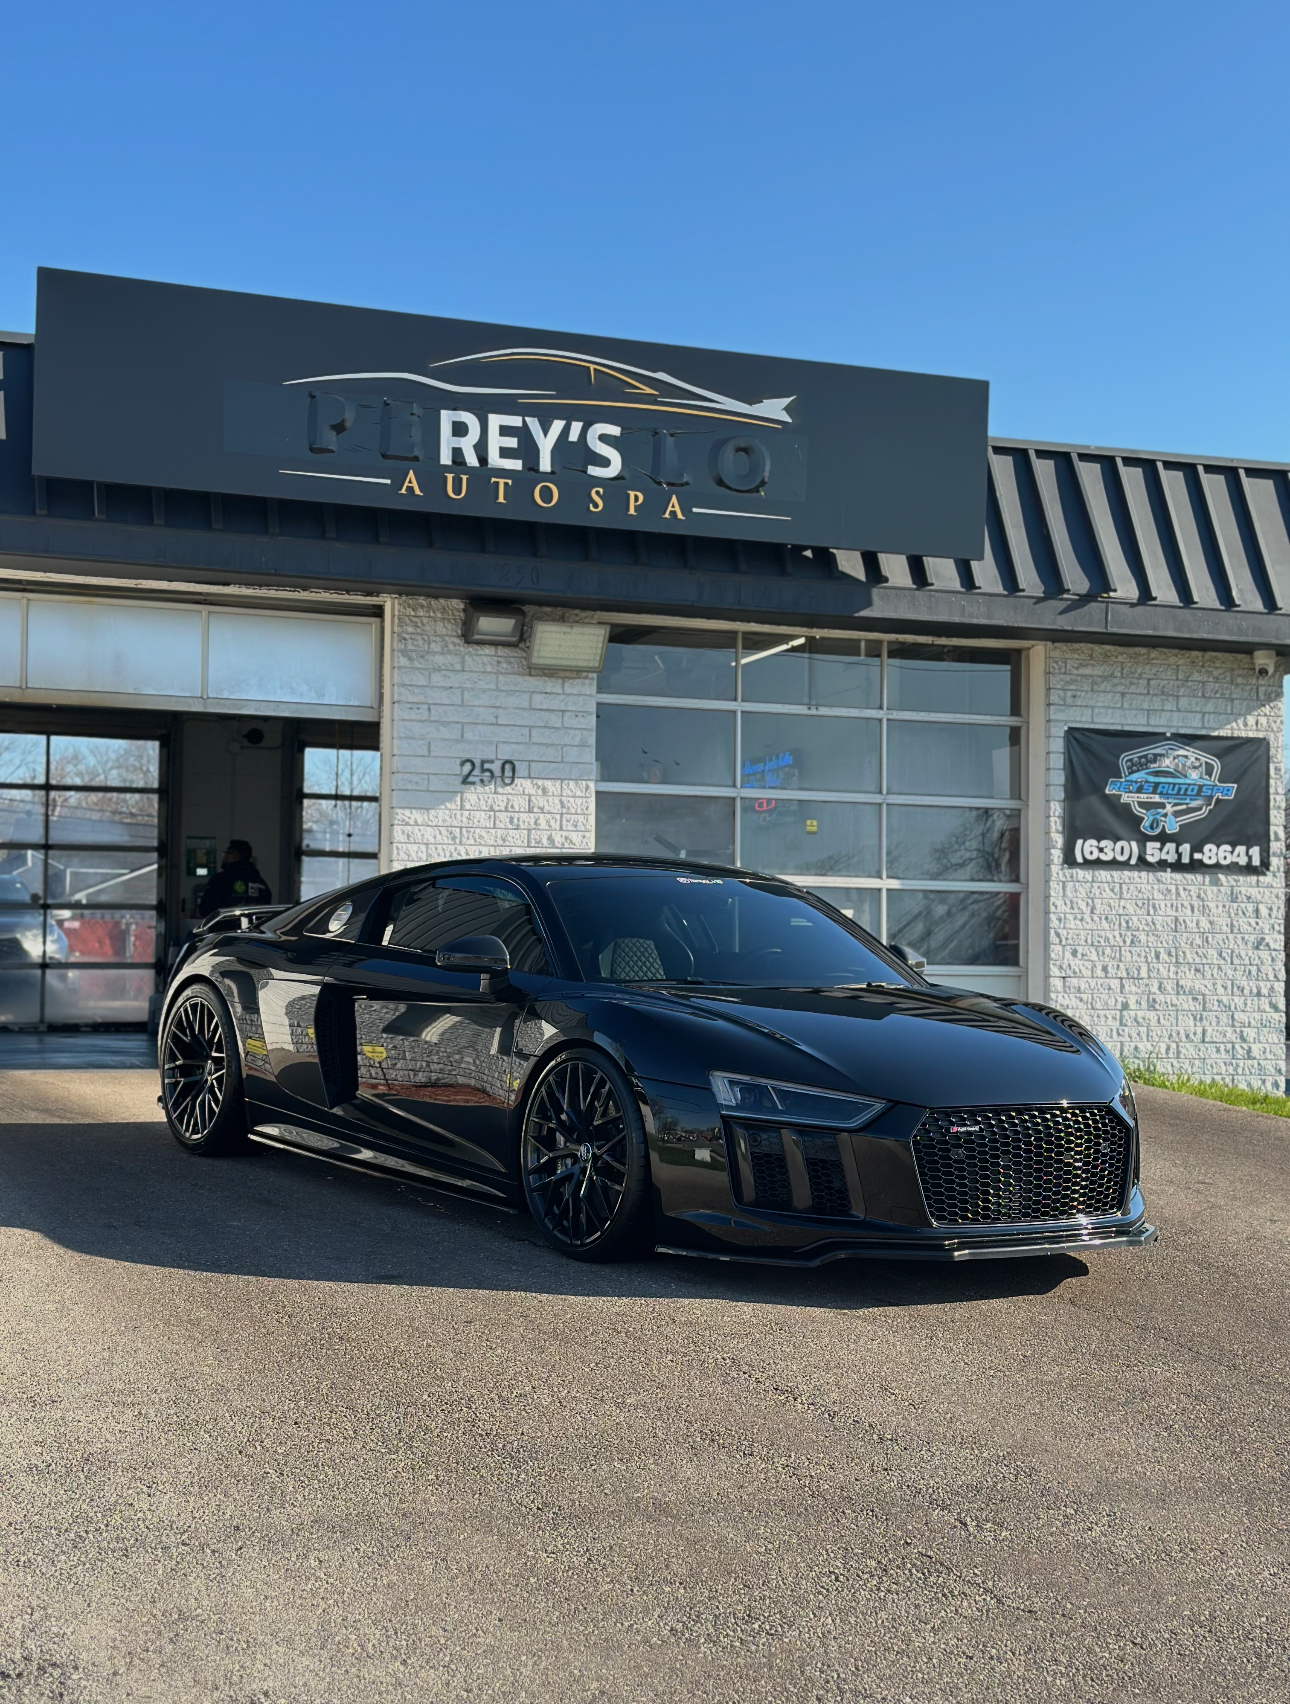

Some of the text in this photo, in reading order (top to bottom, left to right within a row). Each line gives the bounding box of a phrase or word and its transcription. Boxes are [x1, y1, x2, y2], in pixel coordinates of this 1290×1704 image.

[439, 409, 623, 479] REY'S
[460, 758, 516, 786] 250
[1108, 780, 1235, 797] REY'S AUTO SPA
[1074, 838, 1261, 867] (630) 541-8641
